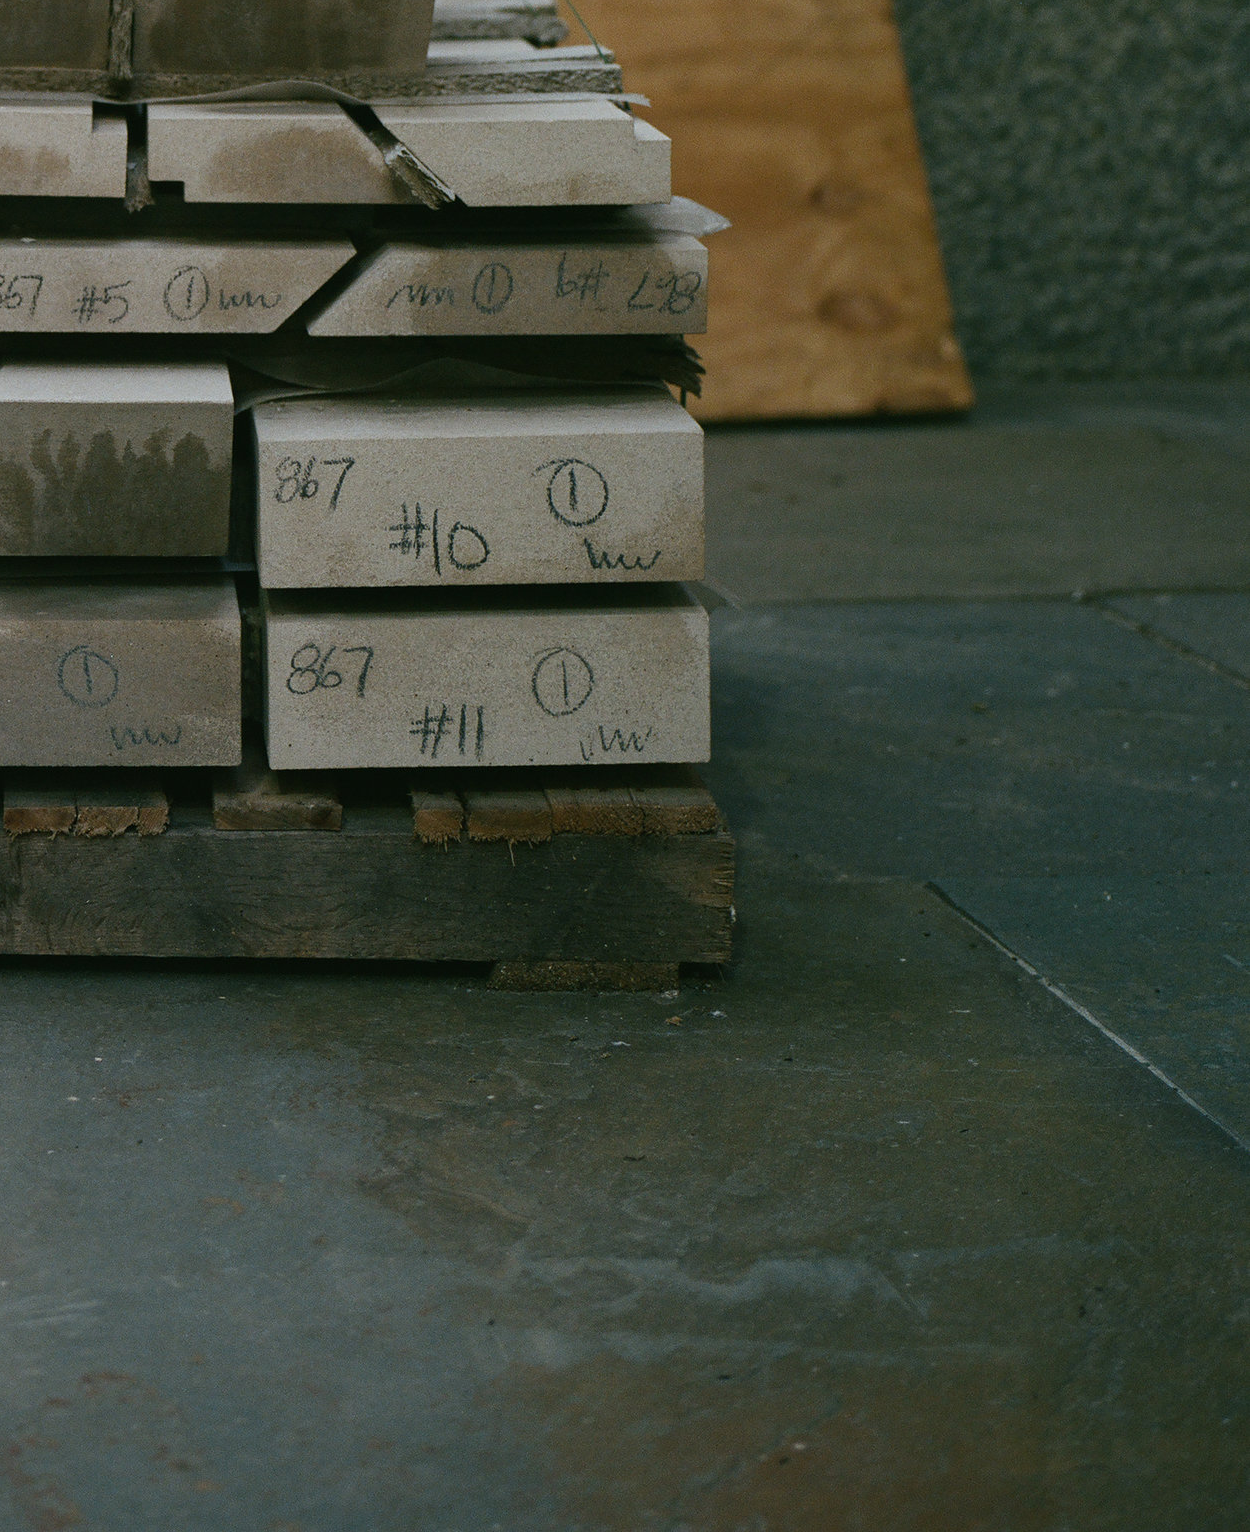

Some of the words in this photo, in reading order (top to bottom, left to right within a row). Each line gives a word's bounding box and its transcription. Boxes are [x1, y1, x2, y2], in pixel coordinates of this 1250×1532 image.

[71, 280, 131, 324] #5
[273, 456, 355, 511] 867
[384, 500, 491, 576] #10
[286, 642, 375, 698] 867
[408, 703, 485, 760] #11
